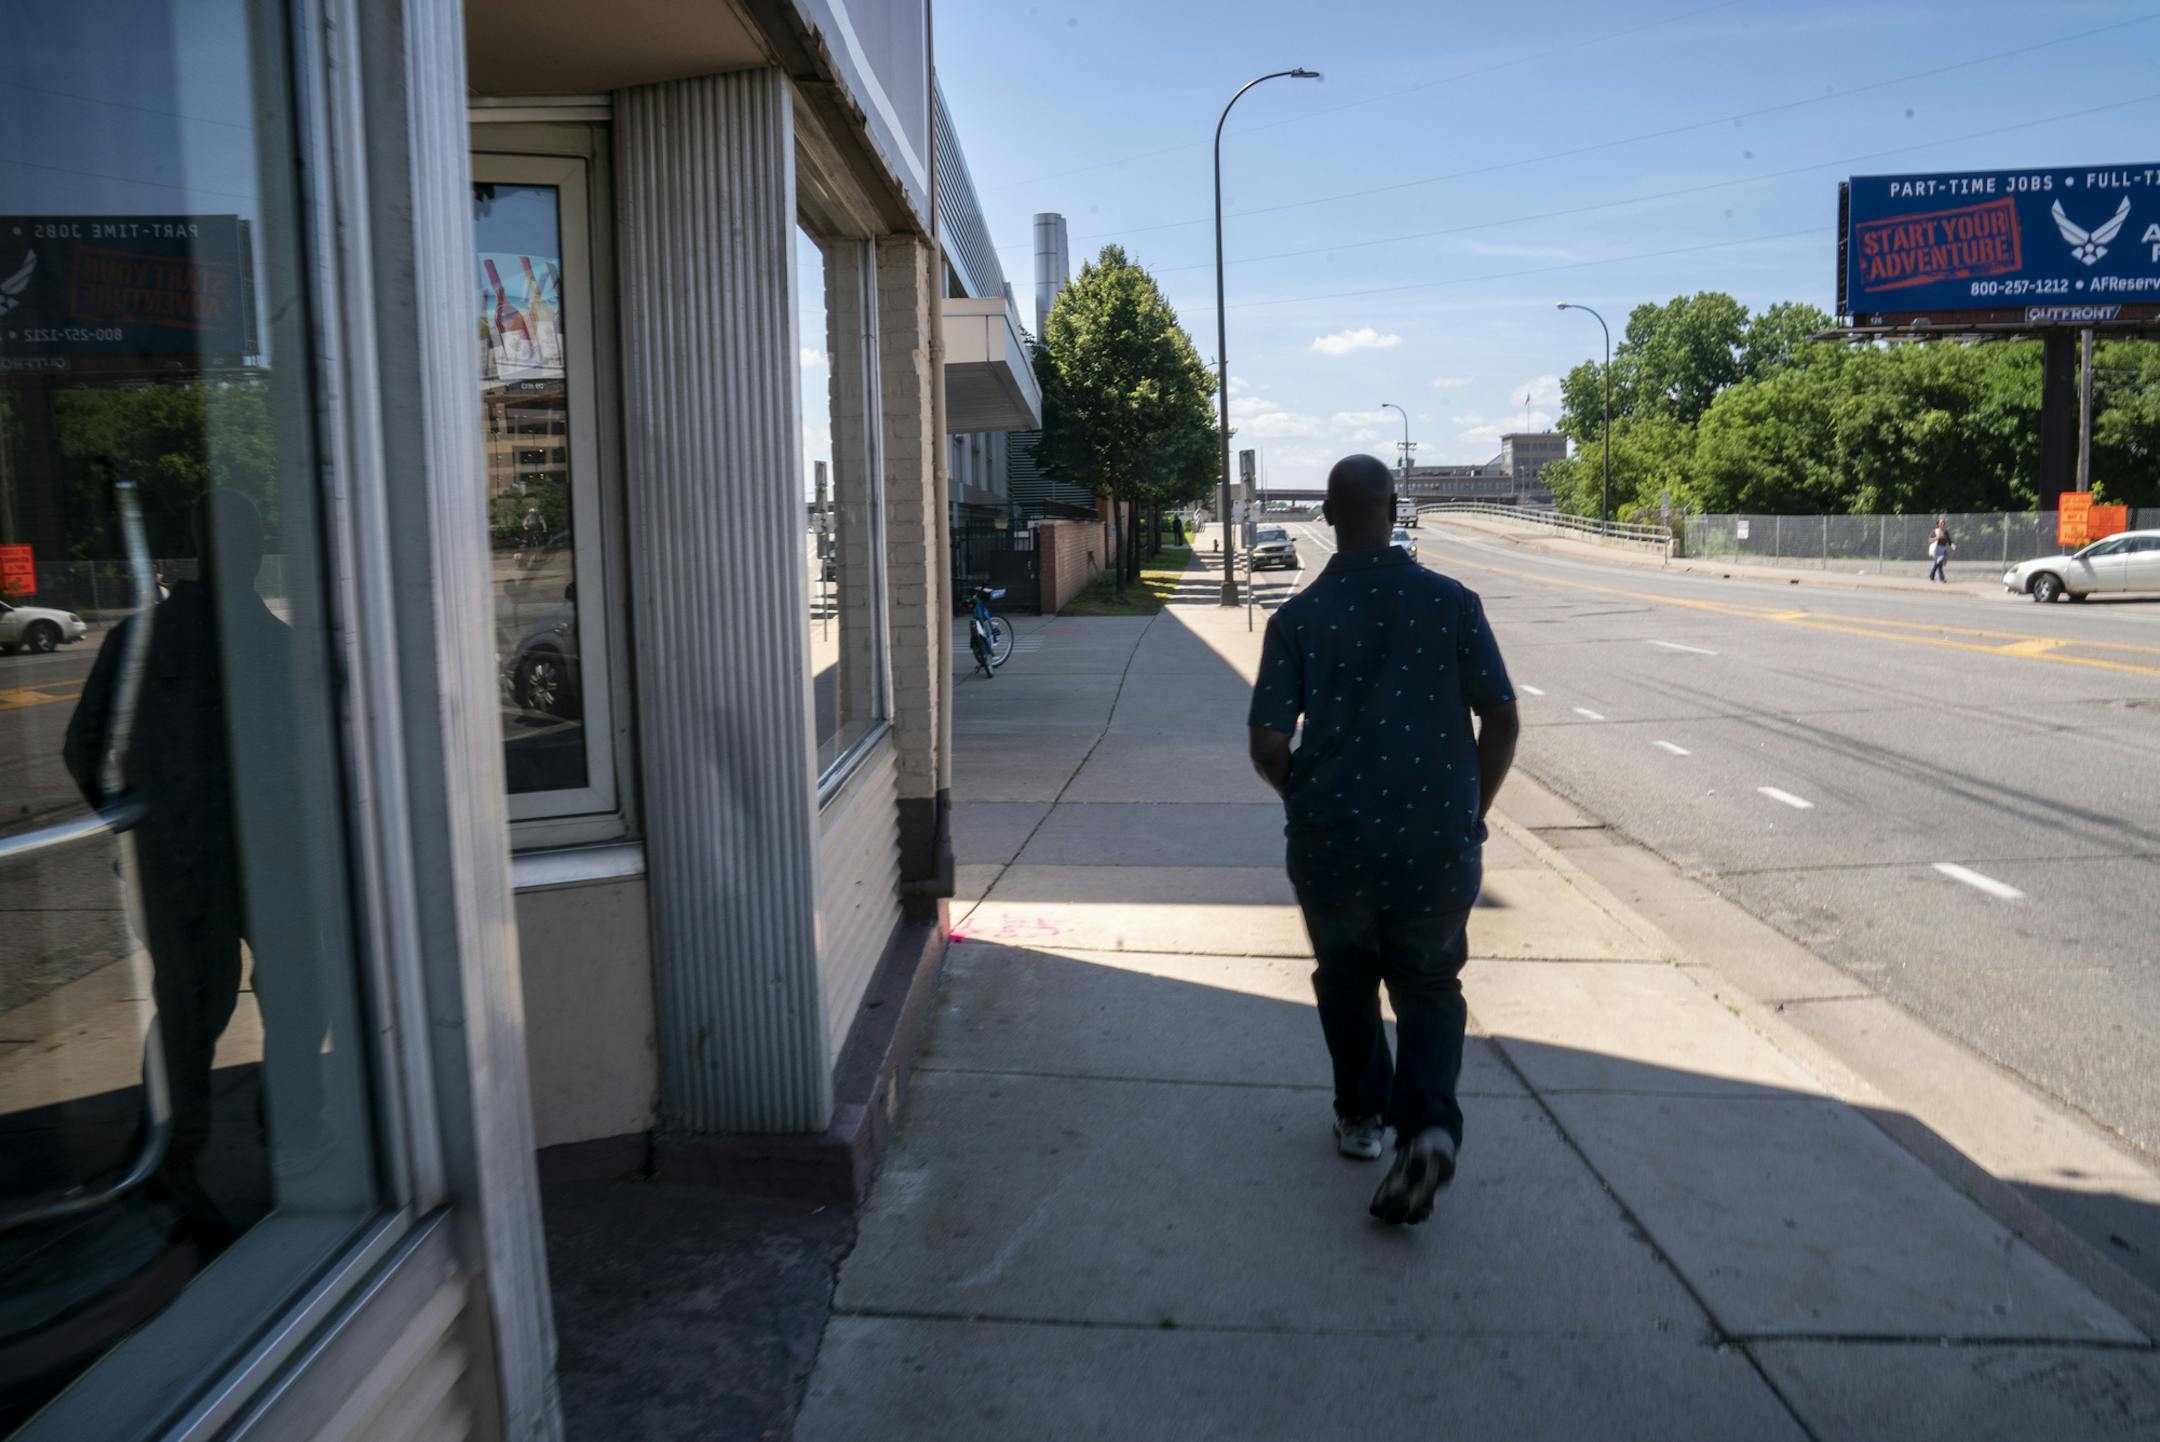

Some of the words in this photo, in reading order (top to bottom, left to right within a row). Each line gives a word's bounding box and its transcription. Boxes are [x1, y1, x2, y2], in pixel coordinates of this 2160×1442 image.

[1890, 177, 1996, 198] PART-TIME
[2006, 175, 2053, 192] JOBS
[1864, 221, 1937, 255] START
[1941, 208, 2008, 245] YOUR
[1869, 236, 2009, 281] ADVENTURE
[1971, 278, 2069, 296] 800-257-1212
[2029, 306, 2115, 320] OUTFRONT
